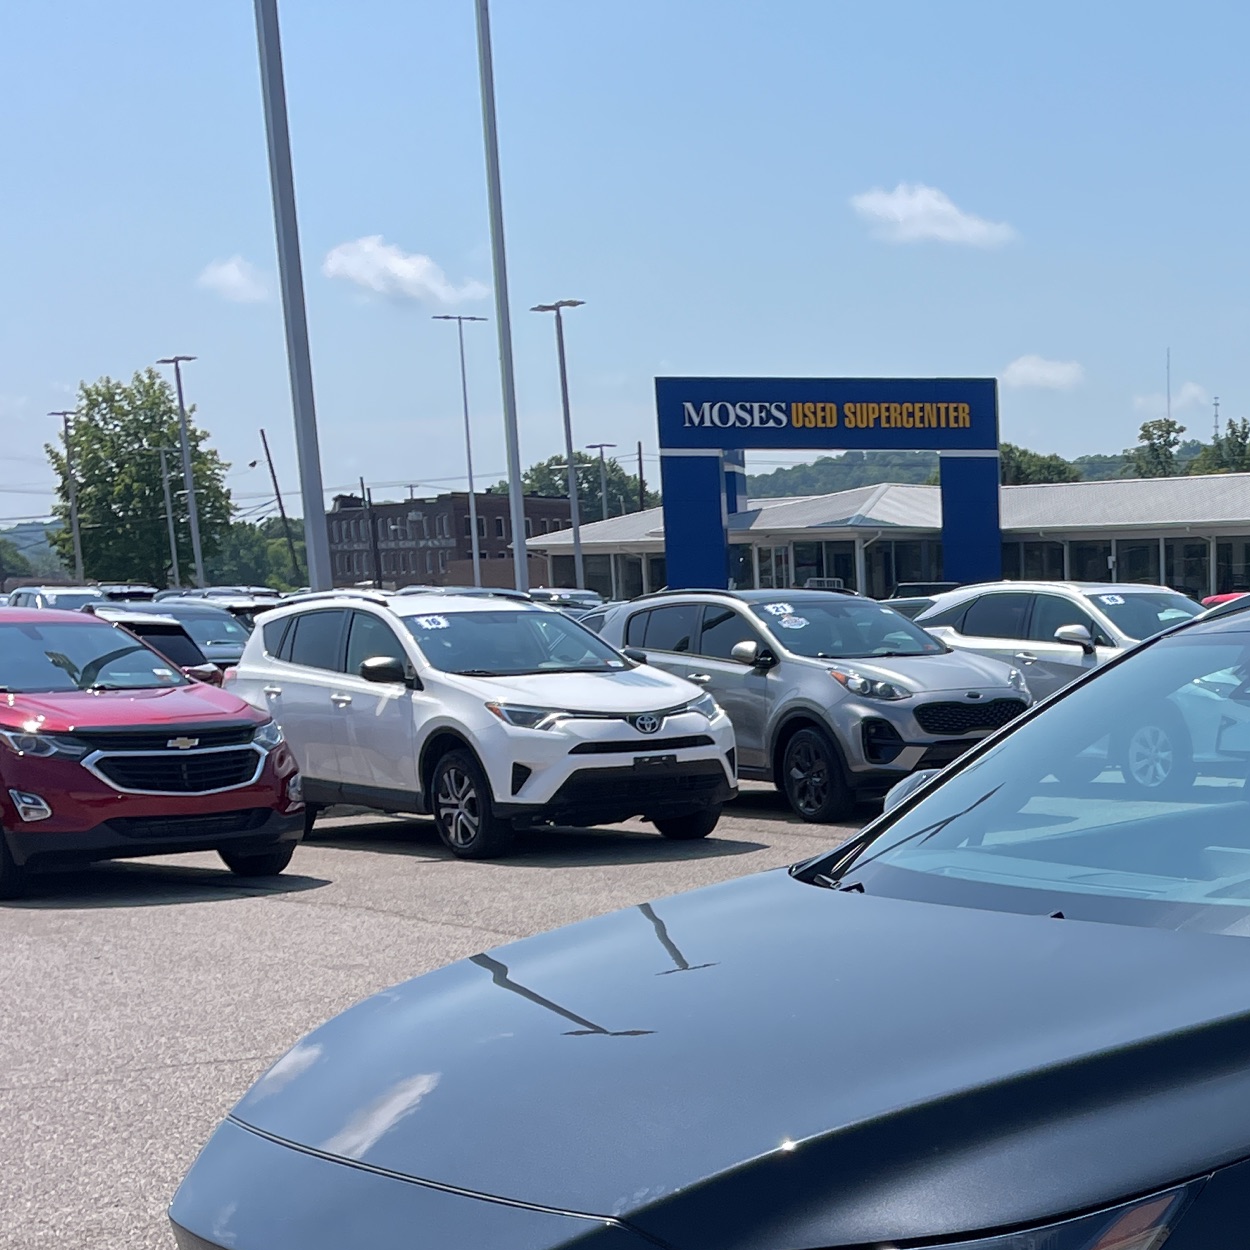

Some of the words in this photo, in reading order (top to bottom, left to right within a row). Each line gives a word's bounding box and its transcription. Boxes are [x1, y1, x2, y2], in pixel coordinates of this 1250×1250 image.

[682, 401, 788, 428] MOSES
[790, 402, 838, 429] USED
[843, 402, 971, 429] SUPERCENTER
[772, 604, 788, 614] 21
[424, 618, 442, 627] 16
